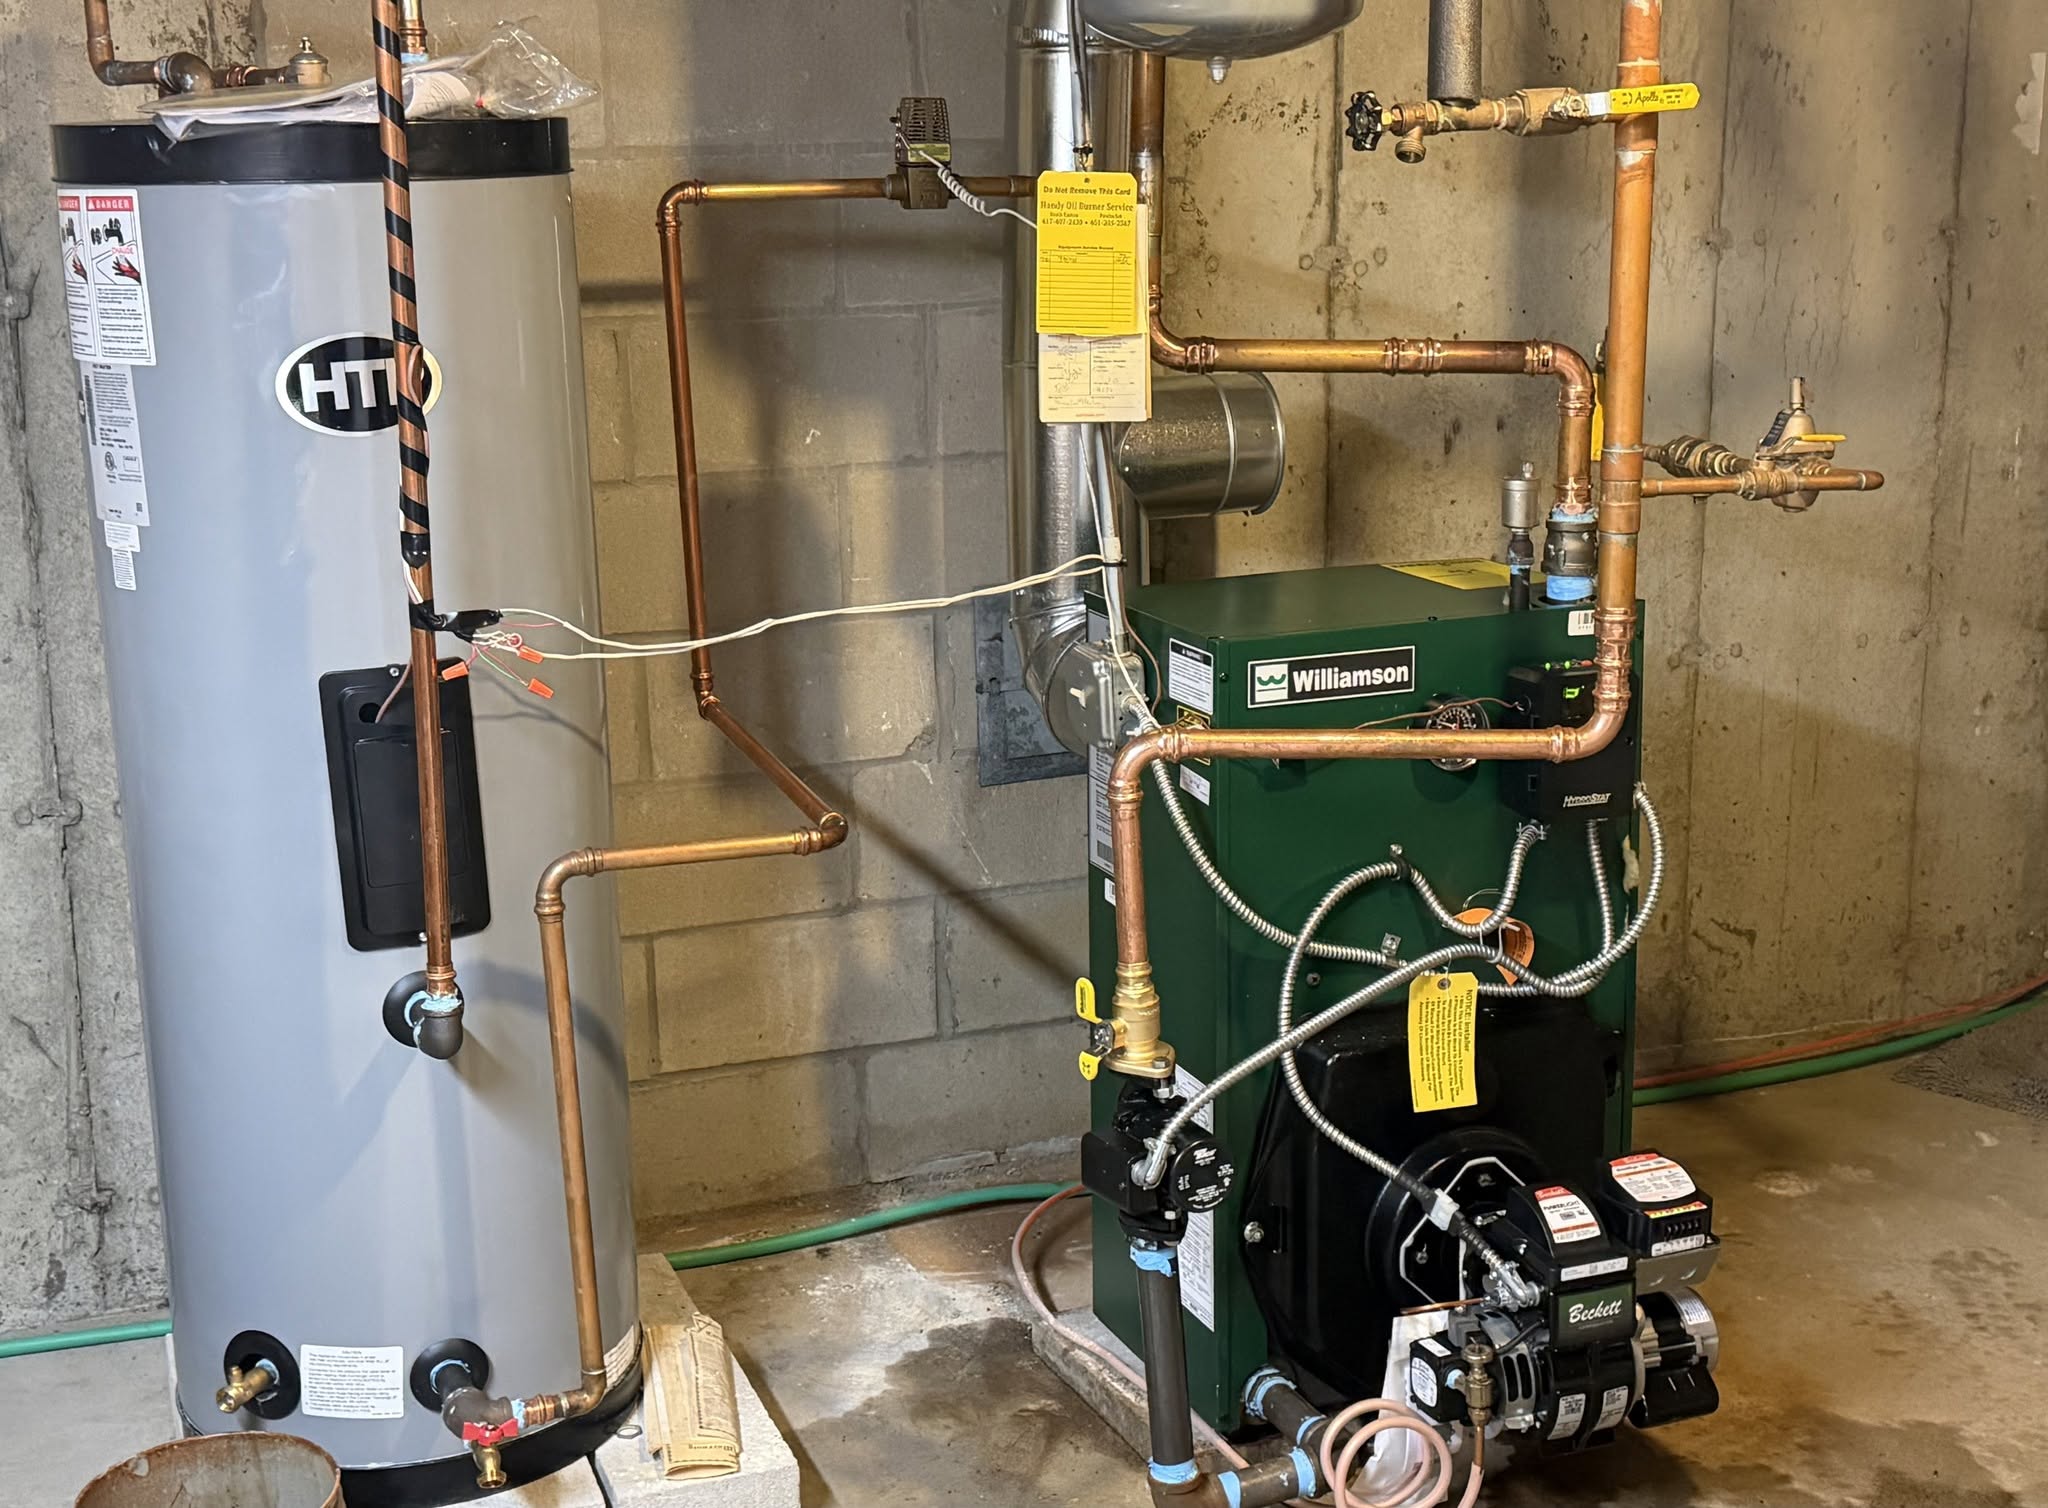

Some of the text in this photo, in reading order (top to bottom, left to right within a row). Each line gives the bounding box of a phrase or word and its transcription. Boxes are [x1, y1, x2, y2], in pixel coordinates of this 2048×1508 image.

[1043, 186, 1053, 194] Do
[1054, 186, 1068, 194] Not
[1069, 187, 1097, 195] Remove
[1115, 188, 1131, 196] Card
[1066, 202, 1077, 210] Oil
[1079, 202, 1105, 210] Burner
[1106, 203, 1134, 211] Service
[1293, 665, 1409, 693] Williamson
[1569, 1299, 1623, 1324] Beckett
